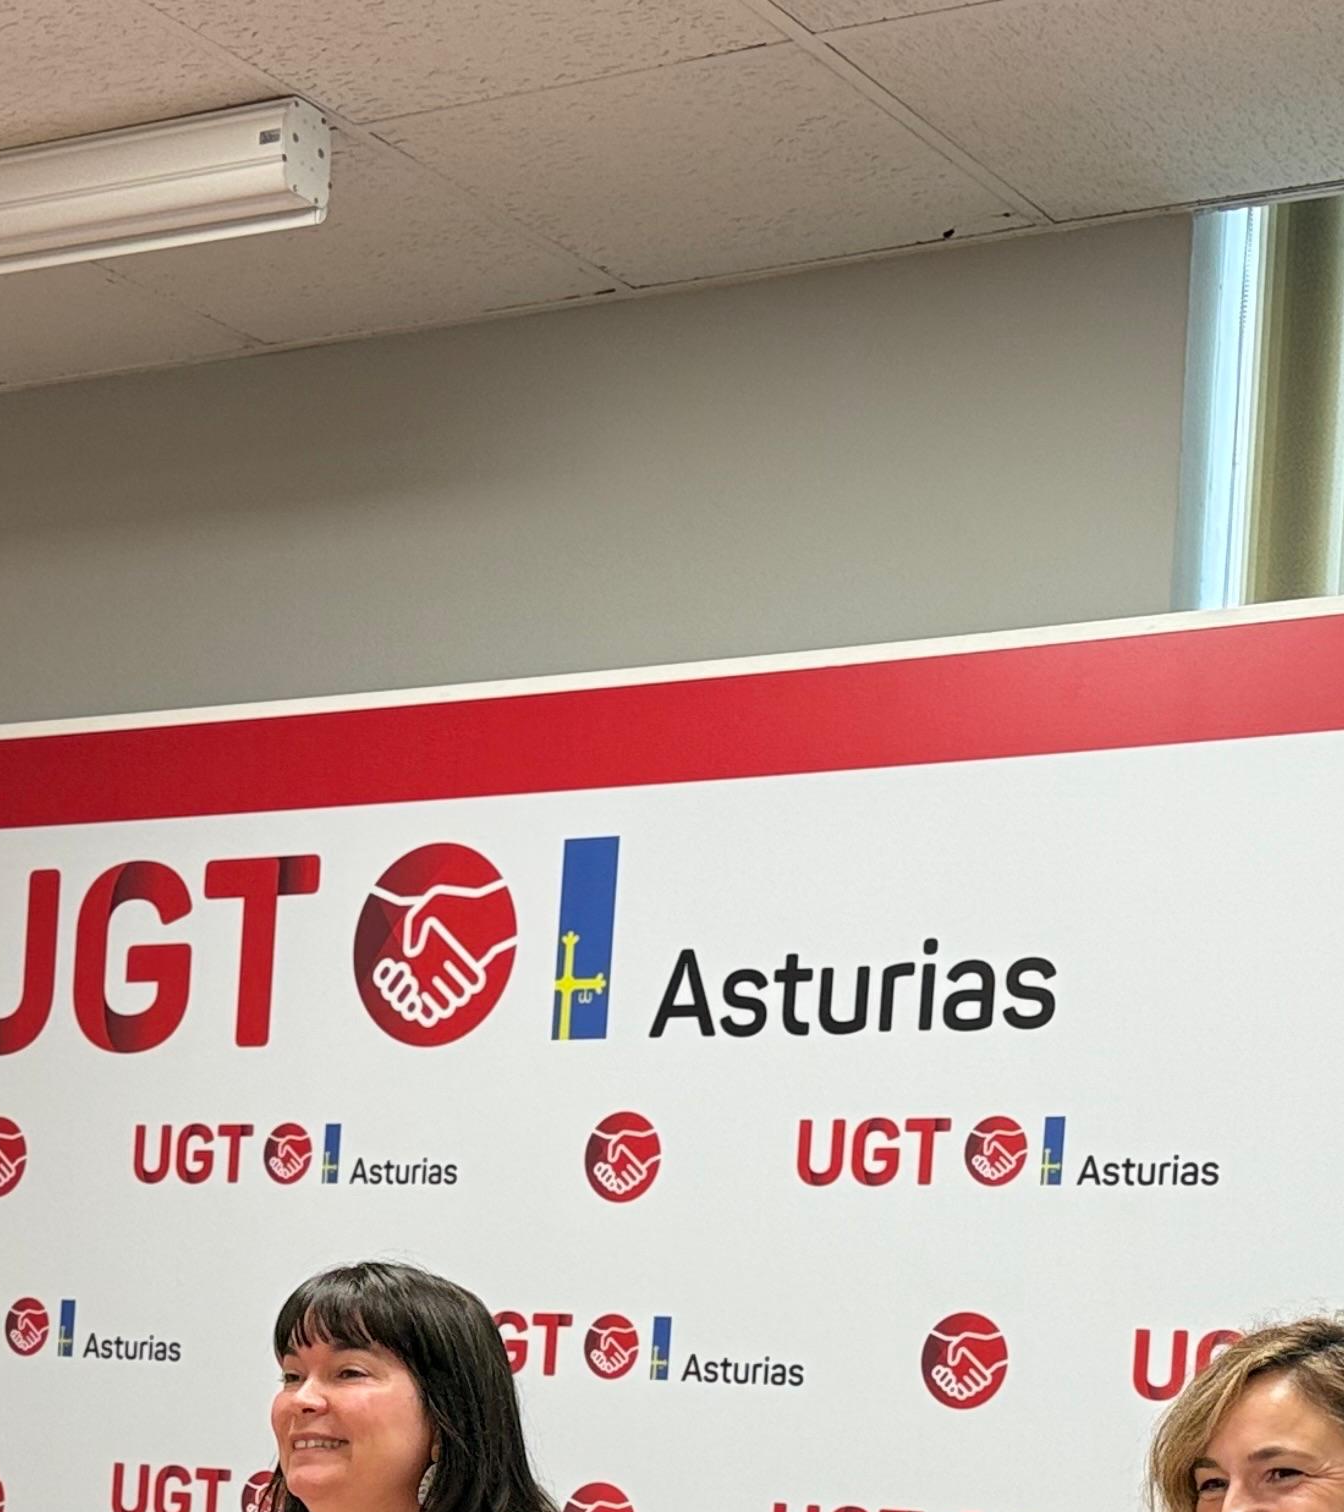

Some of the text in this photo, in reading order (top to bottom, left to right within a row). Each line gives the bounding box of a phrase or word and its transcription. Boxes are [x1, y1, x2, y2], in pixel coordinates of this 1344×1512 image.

[649, 938, 1056, 1038] Asturias
[134, 1123, 457, 1184] UGT Asturias
[797, 1117, 1219, 1186] UGT Asturias
[83, 1333, 180, 1362] Asturias
[494, 1311, 803, 1386] GT Asturias
